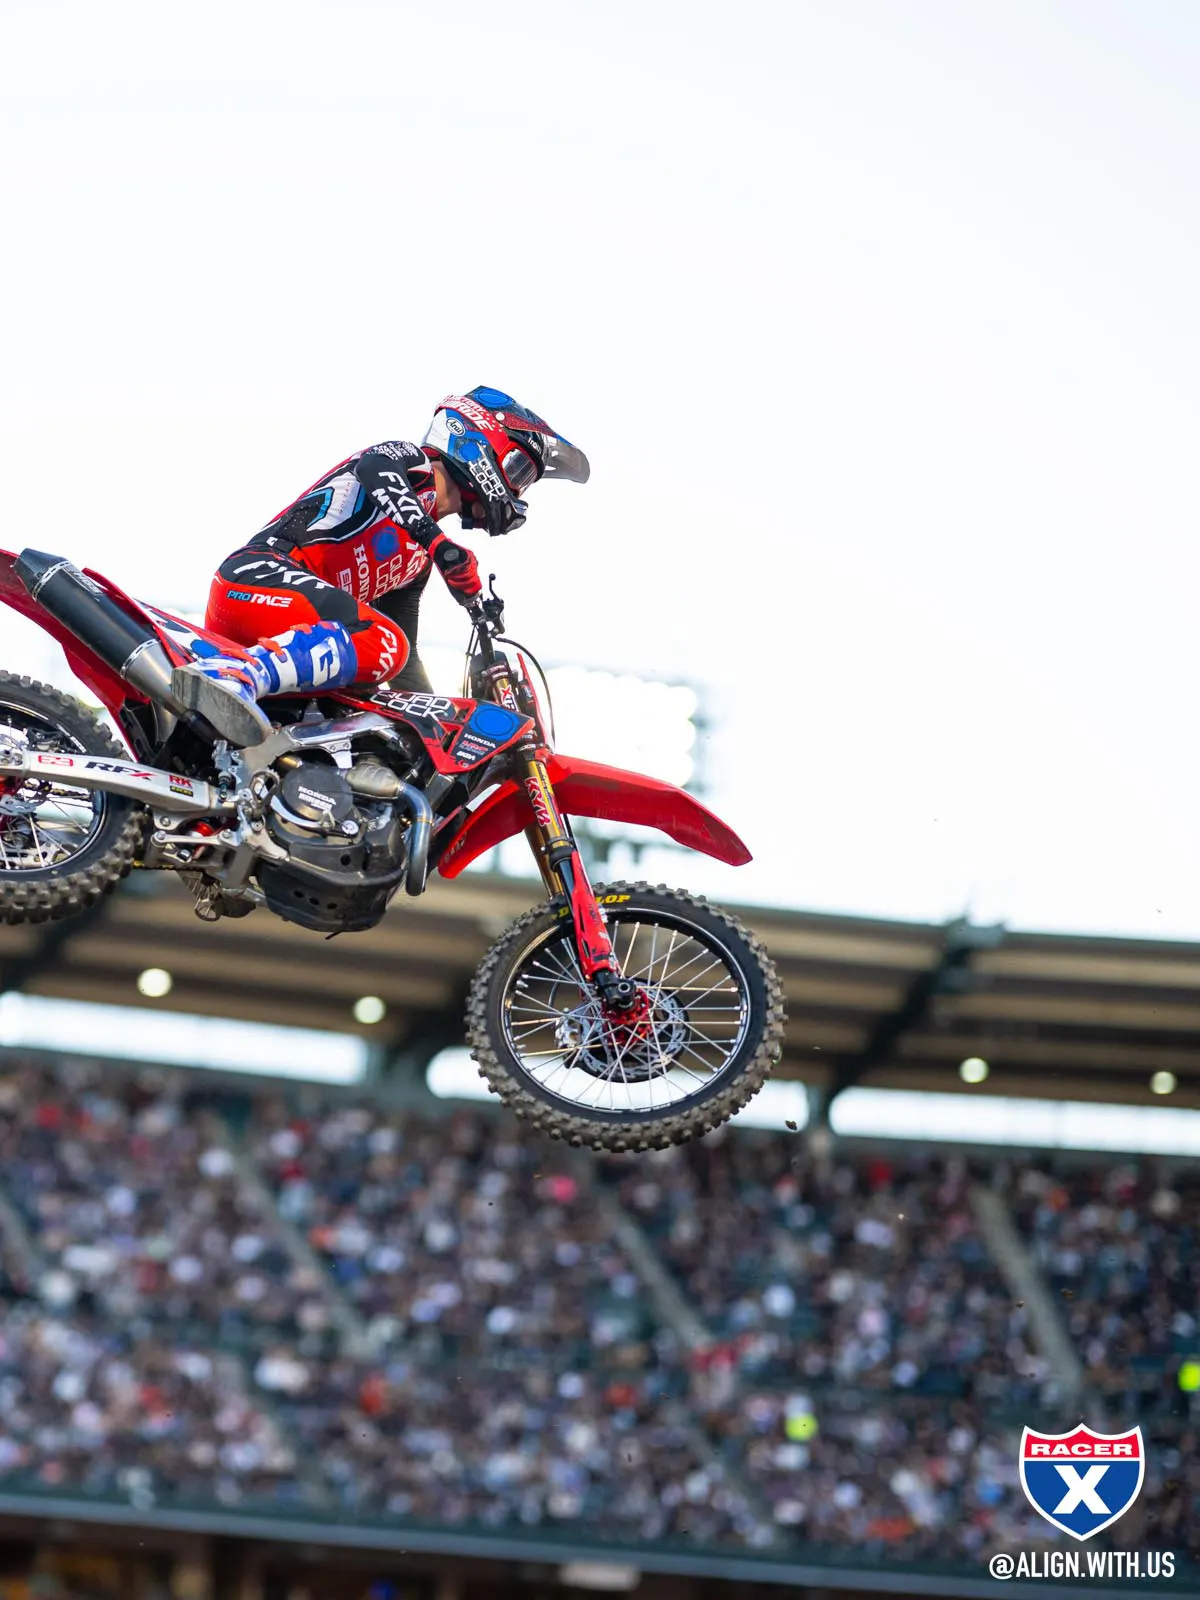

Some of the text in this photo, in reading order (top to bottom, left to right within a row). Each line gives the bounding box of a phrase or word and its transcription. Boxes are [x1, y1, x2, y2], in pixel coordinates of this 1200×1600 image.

[469, 461, 499, 502] LOCK
[479, 458, 506, 496] QUAD
[378, 471, 424, 525] FXR
[354, 543, 370, 605] HOND
[389, 554, 403, 590] QUA
[227, 590, 293, 607] PRO RACE
[369, 693, 443, 722] LOCK
[376, 690, 451, 710] QUAD
[464, 733, 496, 748] HONDA
[168, 774, 193, 787] RK
[298, 786, 336, 805] HONDA
[525, 776, 551, 827] KYB
